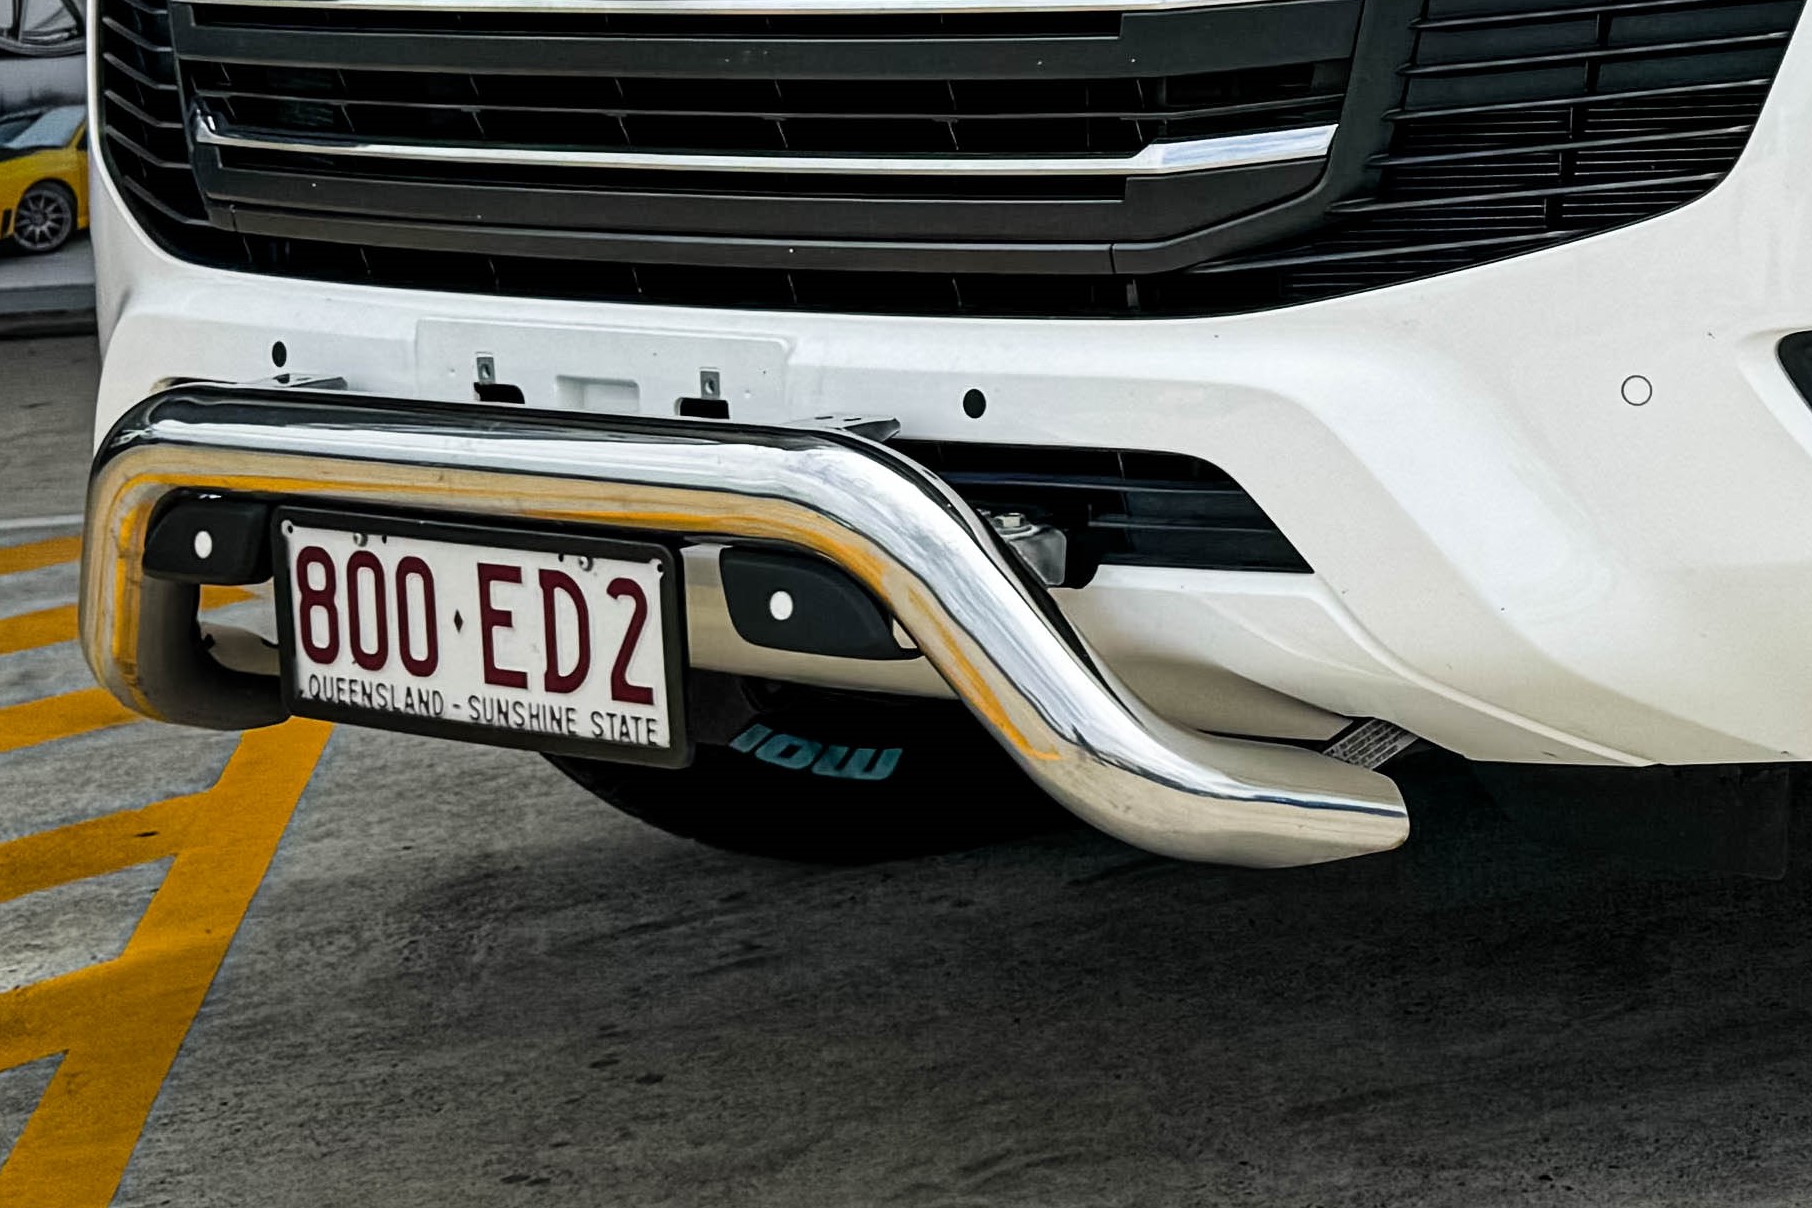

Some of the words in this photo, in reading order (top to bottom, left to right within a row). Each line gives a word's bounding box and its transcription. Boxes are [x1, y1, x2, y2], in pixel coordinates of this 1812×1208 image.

[297, 546, 438, 677] 800
[478, 563, 655, 704] ED2
[309, 674, 443, 716] QUEENSLAND
[469, 696, 577, 734] SUNSHINE
[591, 711, 659, 745] STATE
